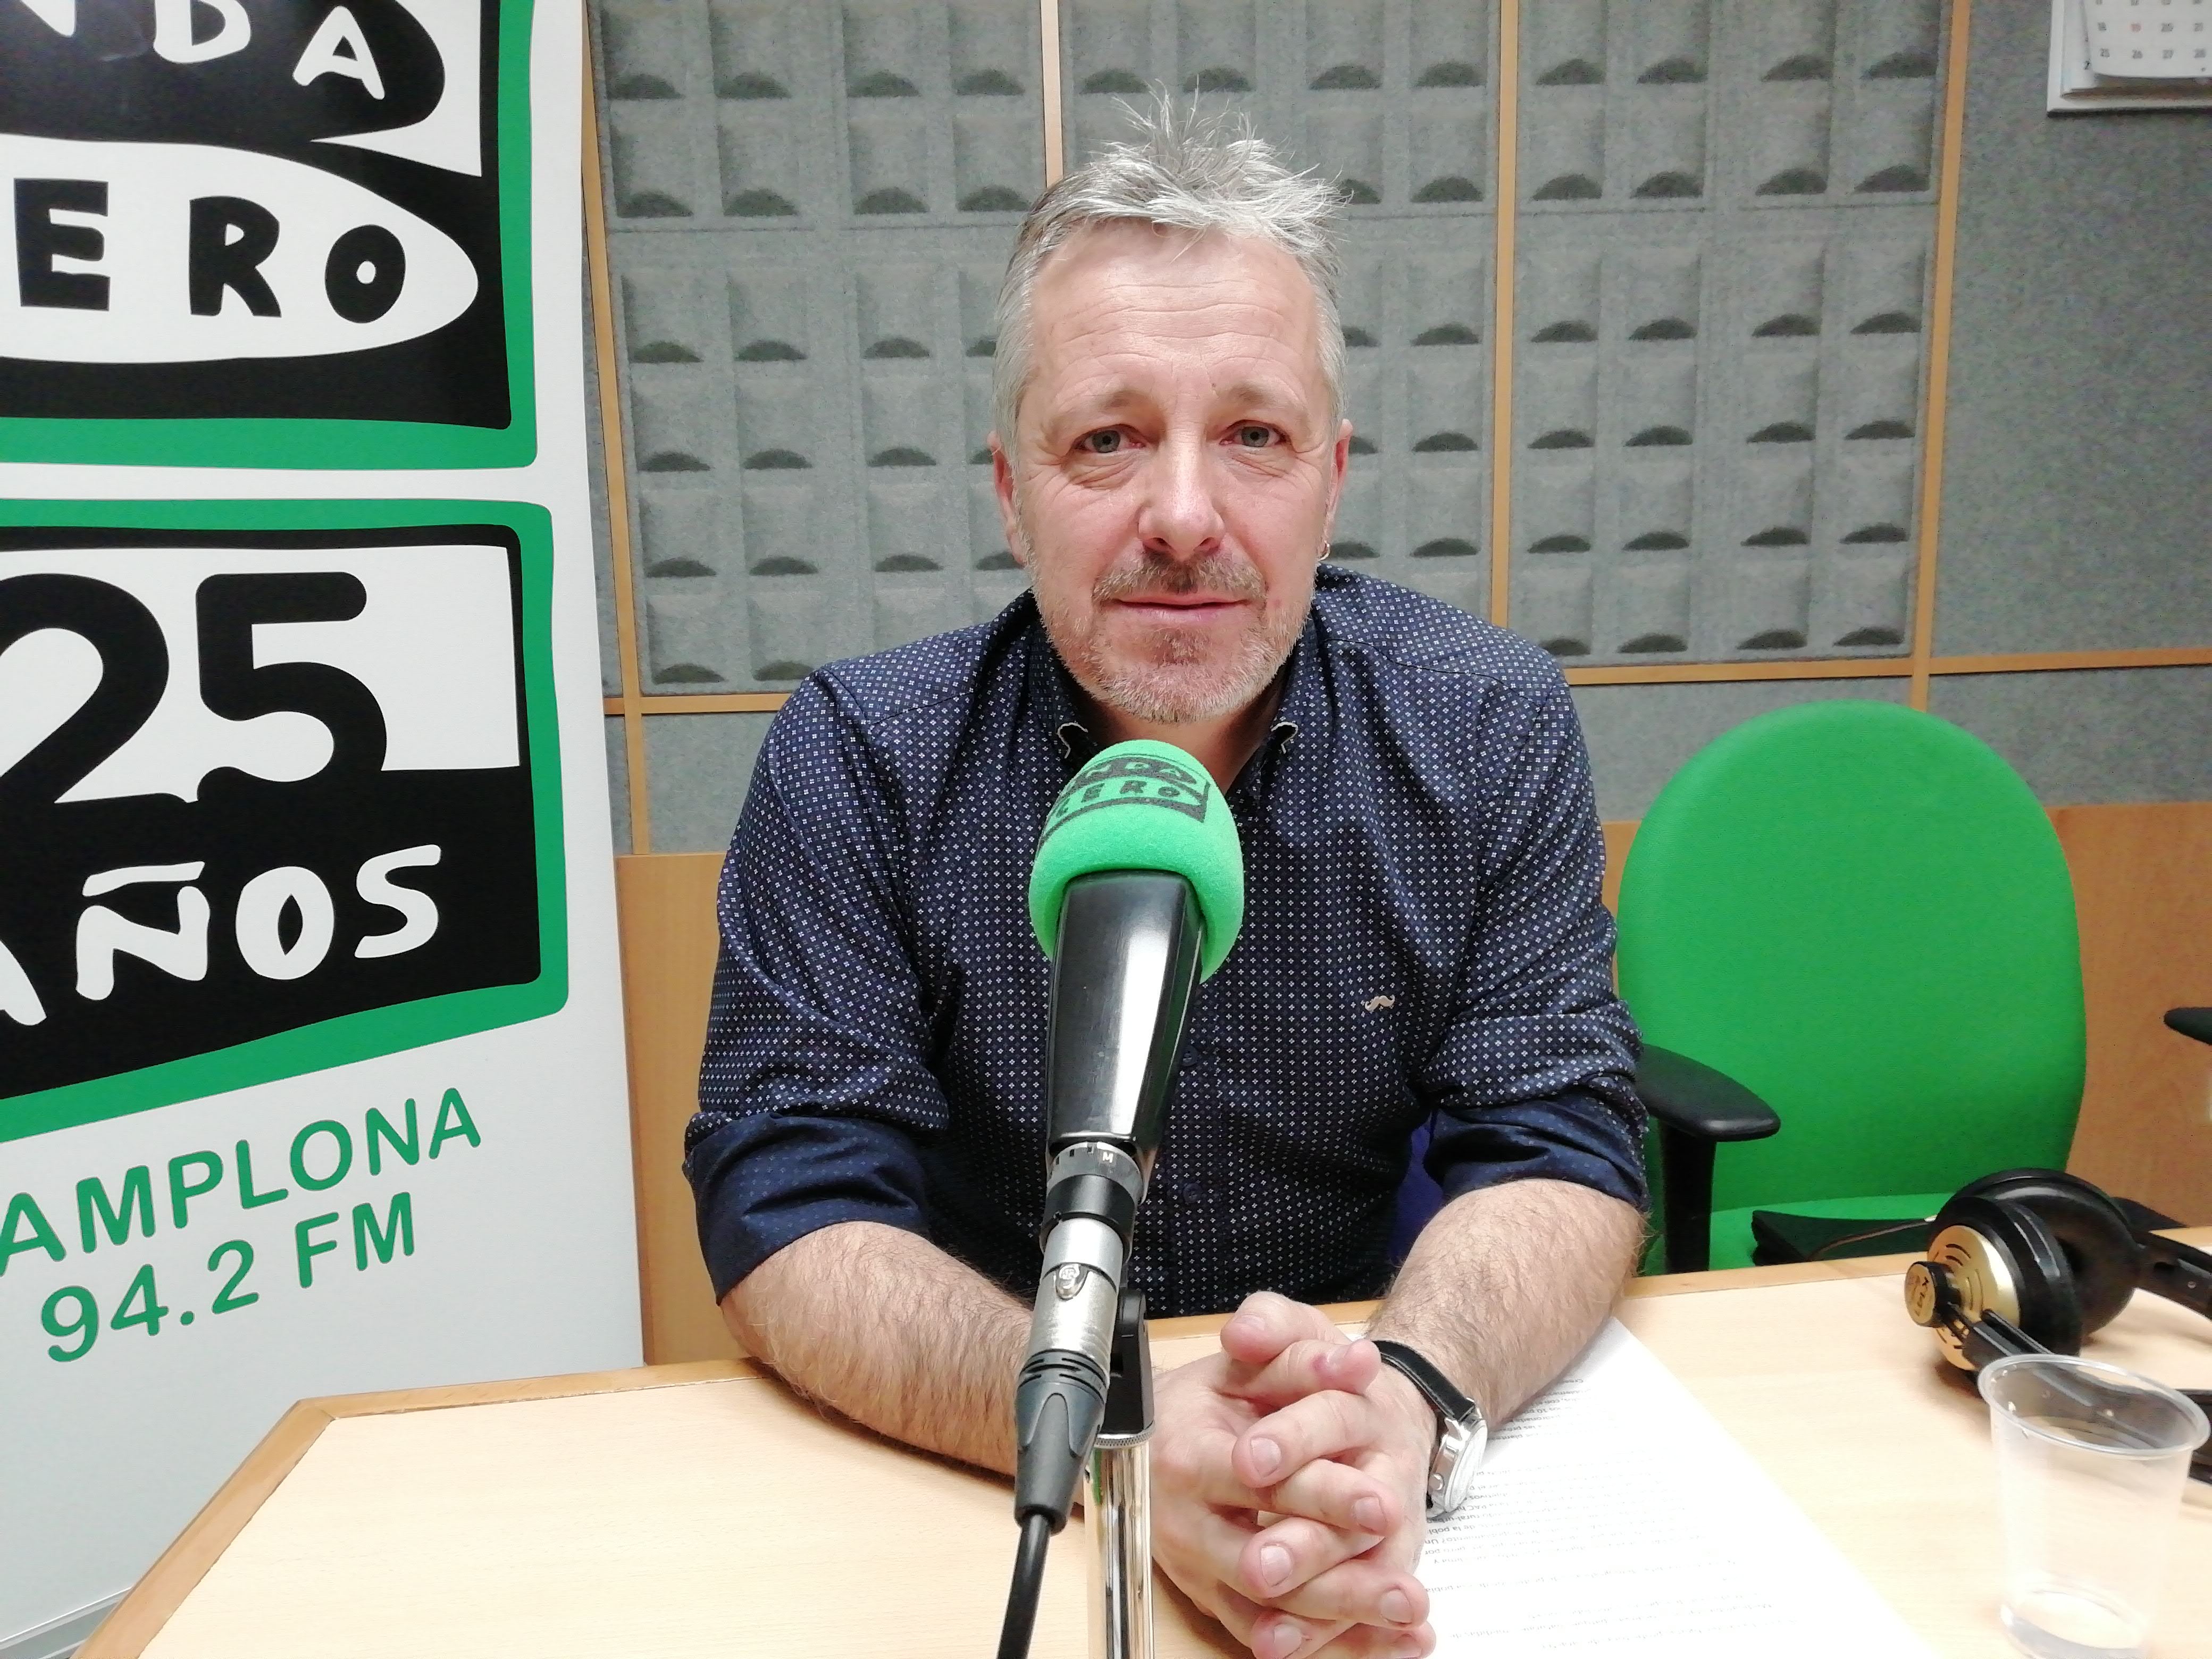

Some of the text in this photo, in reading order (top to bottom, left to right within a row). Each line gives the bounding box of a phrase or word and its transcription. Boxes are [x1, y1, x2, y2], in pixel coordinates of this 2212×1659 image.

[14, 178, 406, 324] ERO
[0, 571, 387, 804] 25
[0, 1087, 481, 1276] AMPLONA
[41, 1191, 415, 1363] 94.2 FM
